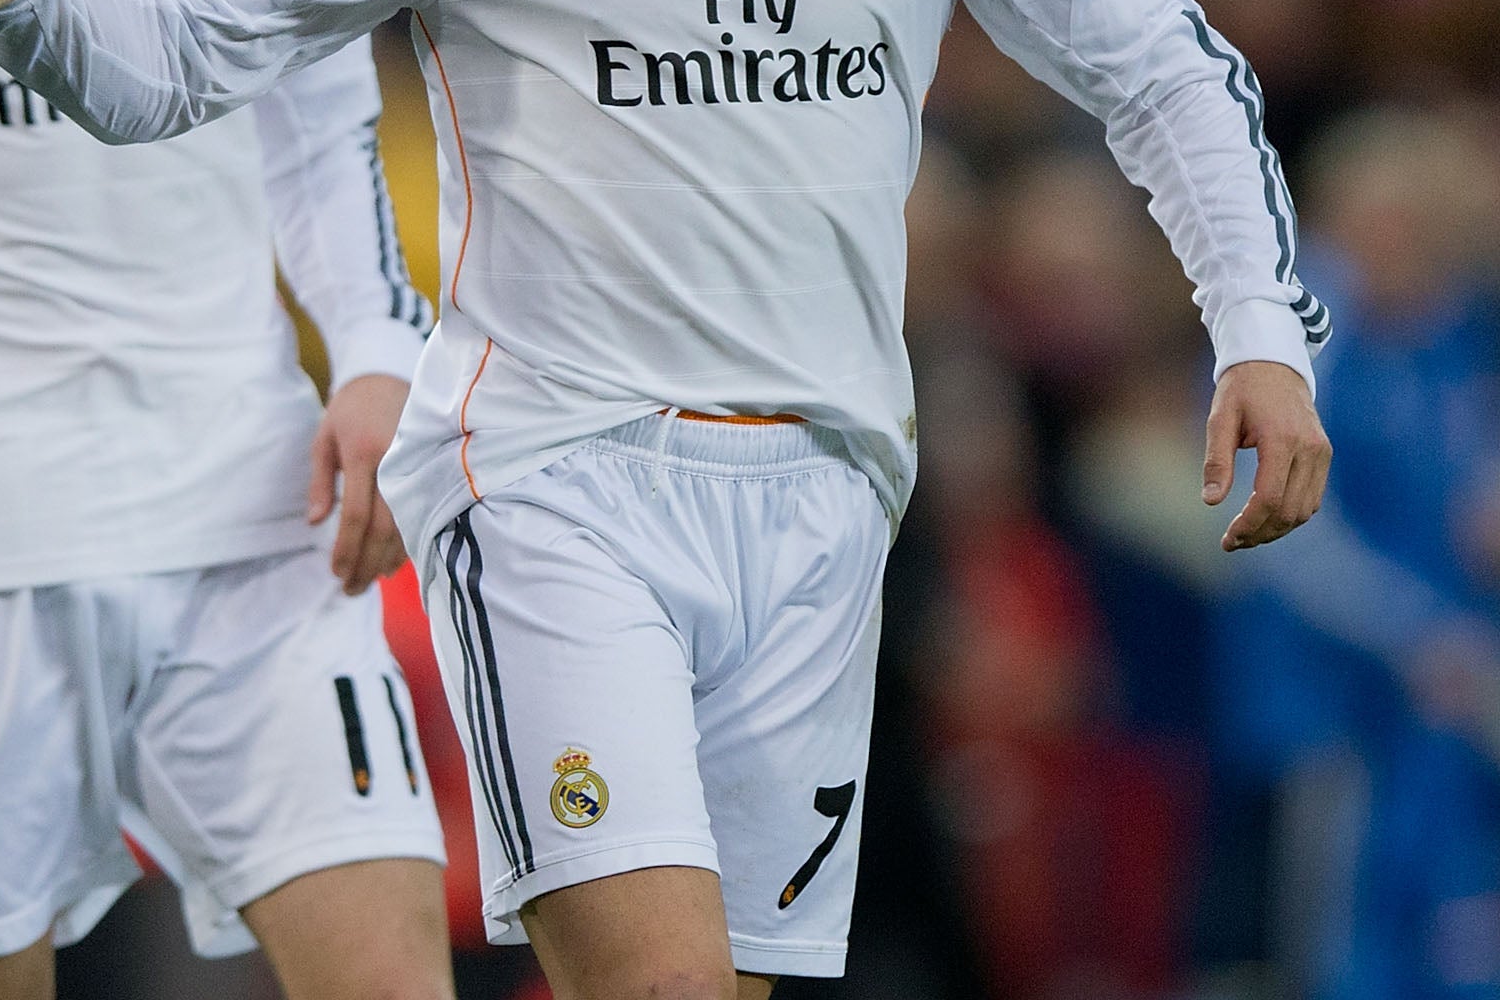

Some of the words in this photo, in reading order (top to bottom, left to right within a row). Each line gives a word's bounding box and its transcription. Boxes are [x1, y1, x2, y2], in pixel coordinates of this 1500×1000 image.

[589, 32, 889, 107] Emirates
[334, 675, 418, 797] 11
[778, 779, 857, 910] 7
